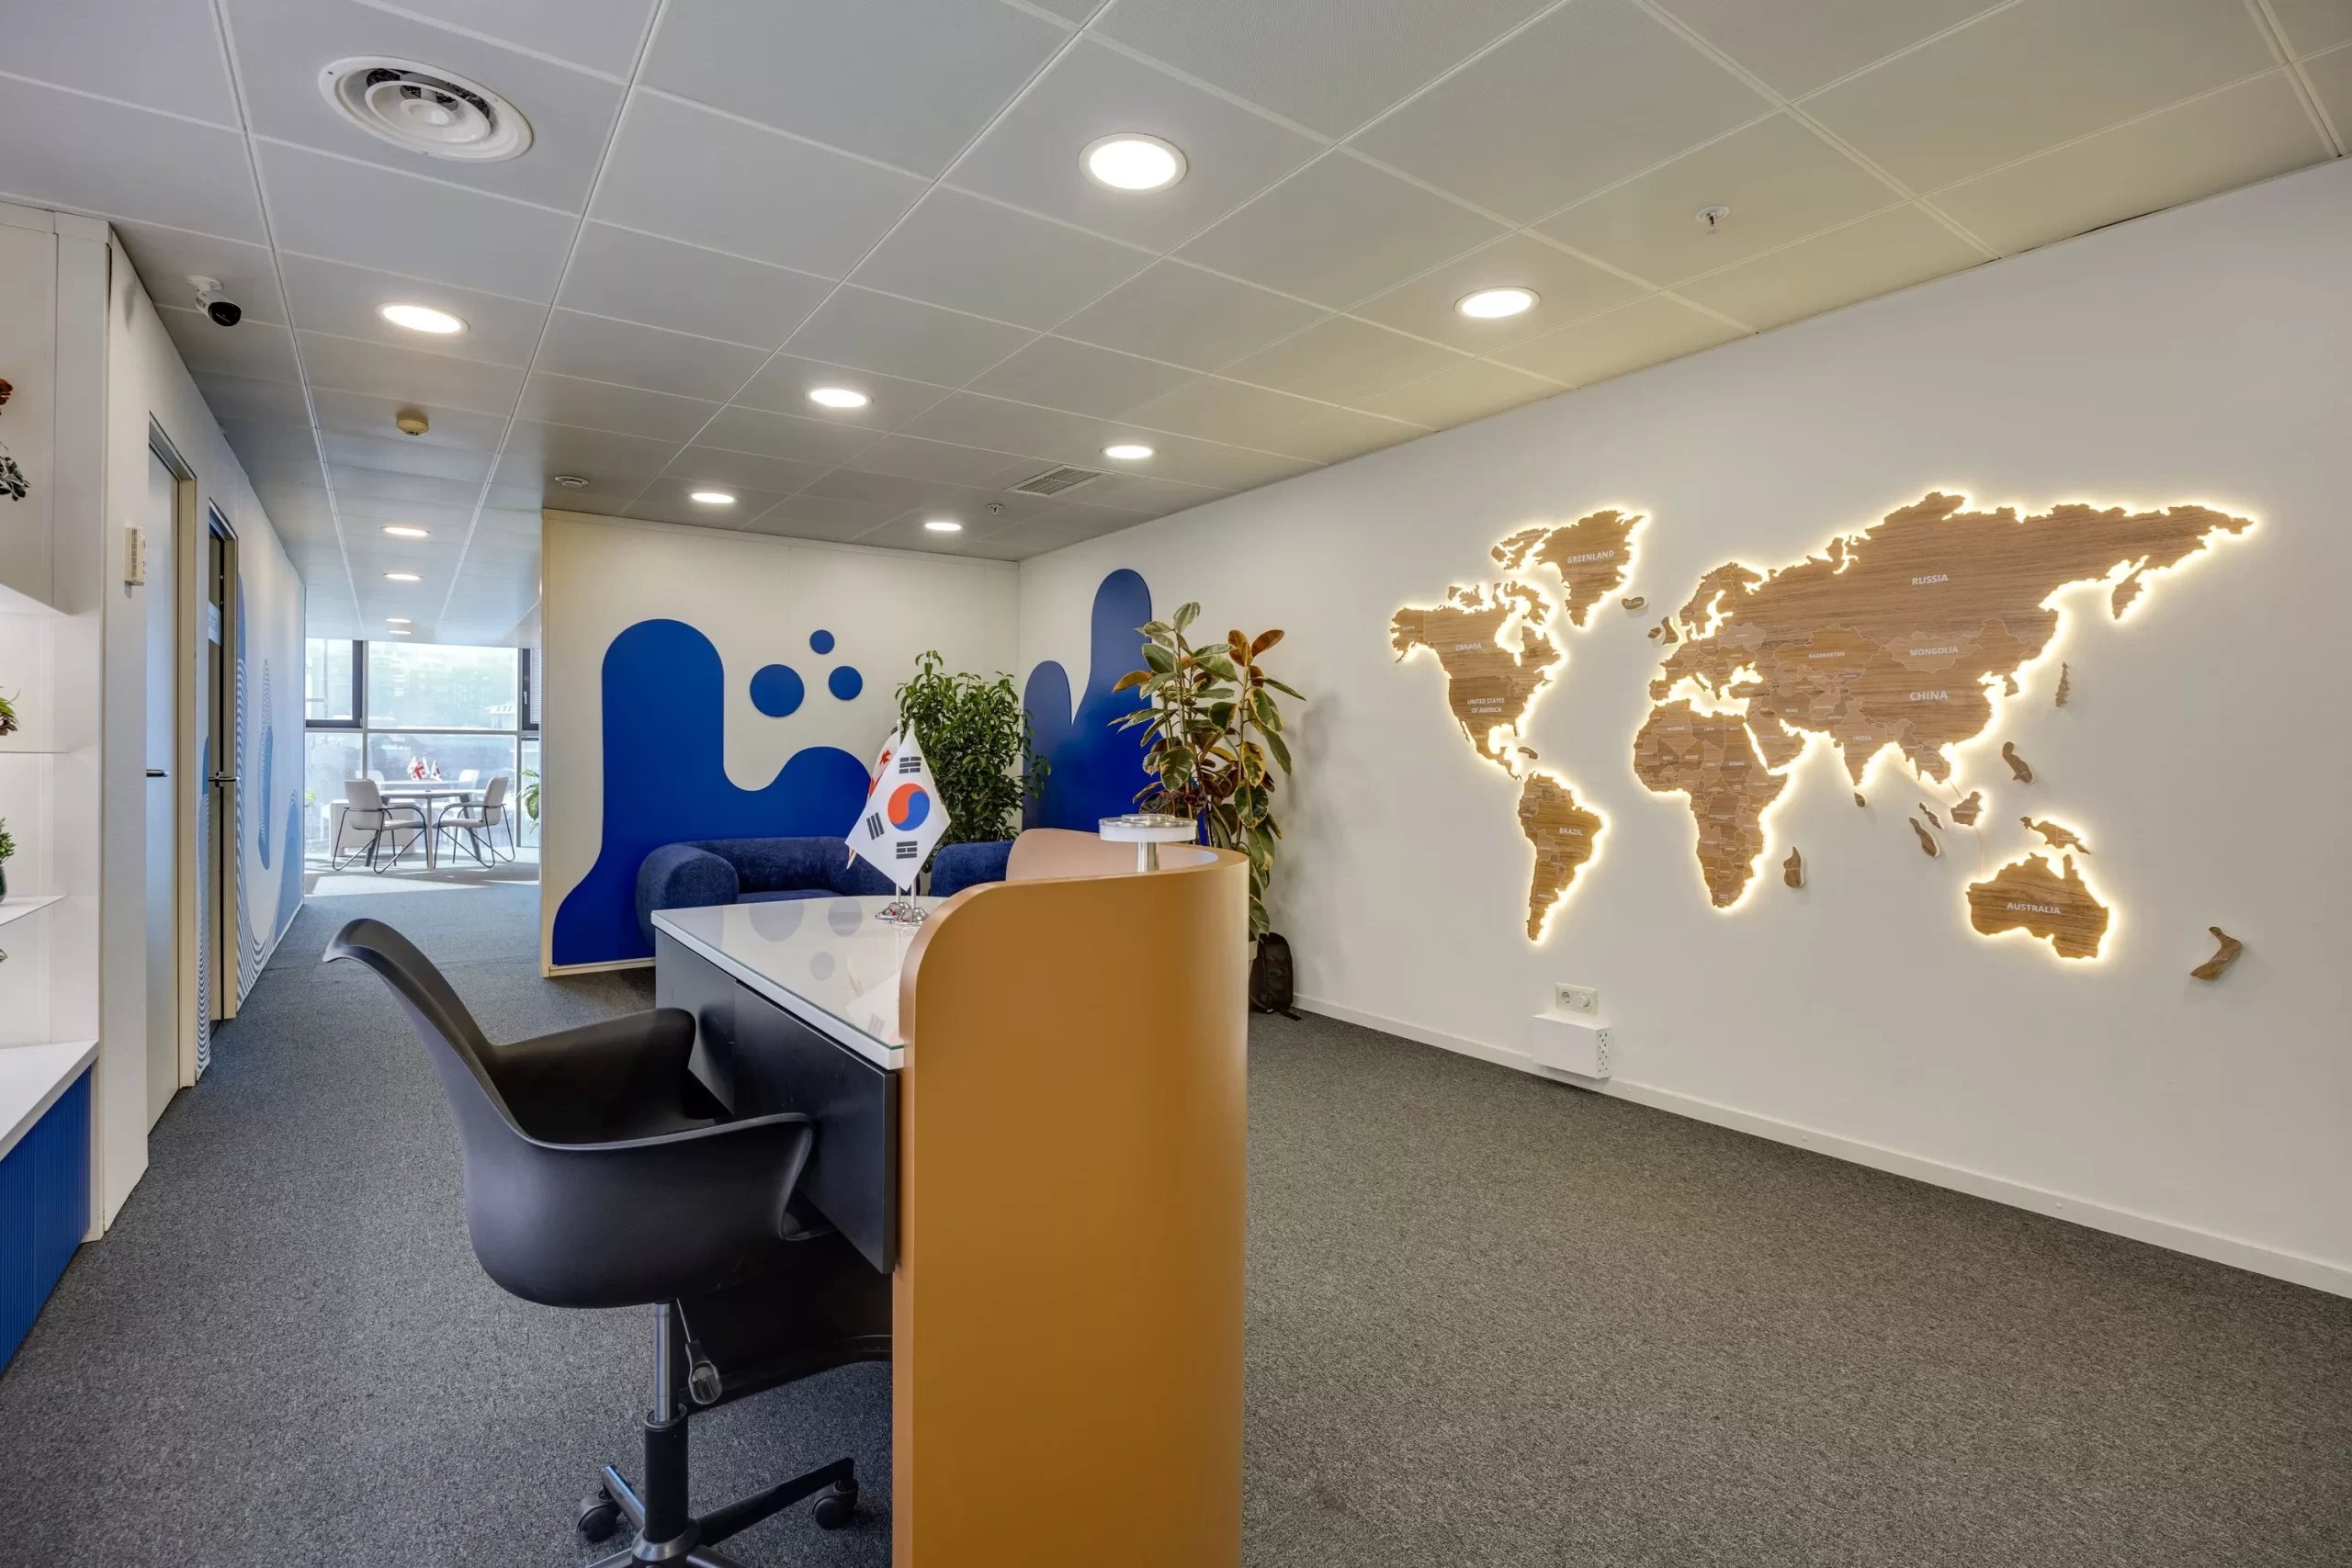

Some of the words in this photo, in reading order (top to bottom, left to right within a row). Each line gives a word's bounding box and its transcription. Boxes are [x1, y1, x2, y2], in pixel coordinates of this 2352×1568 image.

[1566, 549, 1614, 564] GREENLAND
[1911, 573, 1949, 585] RUSSIA
[1455, 642, 1482, 651] CANADA
[1909, 646, 1959, 656] MONGOLIA
[1909, 690, 1949, 701] CHINA
[1558, 827, 1584, 836] BRAZIL
[2007, 902, 2062, 914] AUSTRALIA
